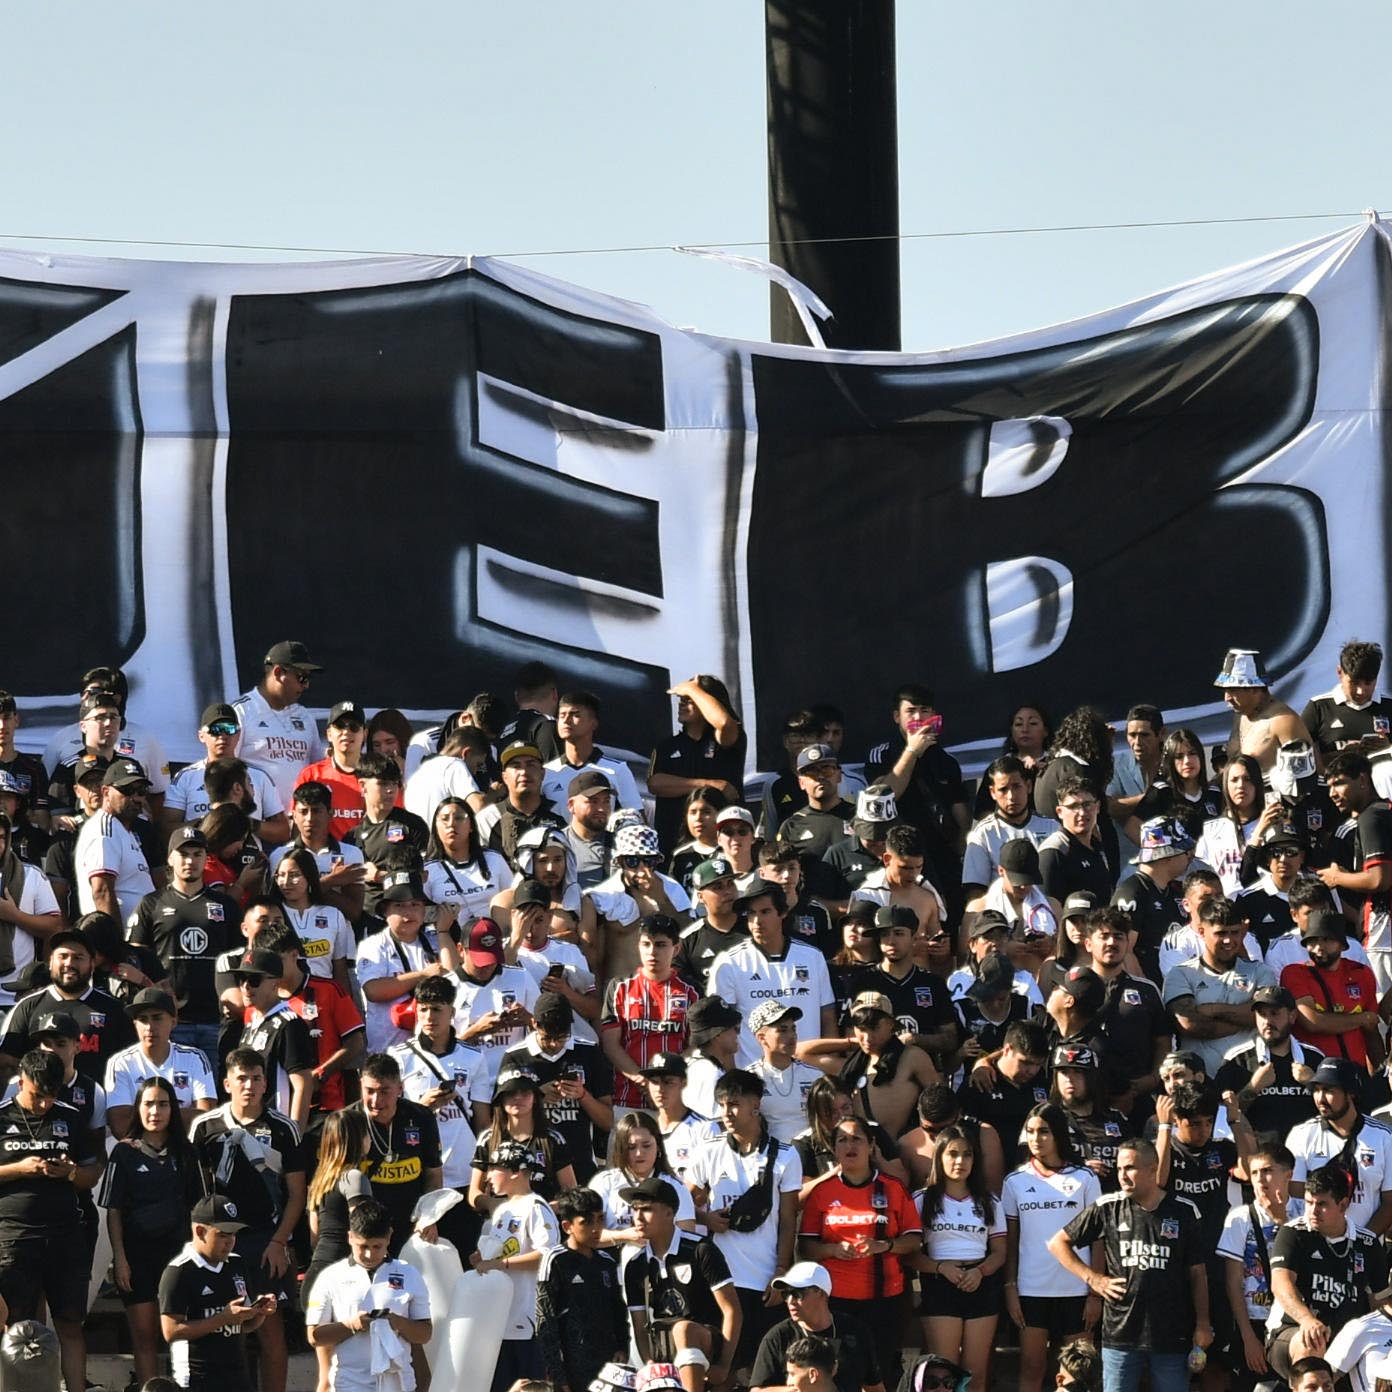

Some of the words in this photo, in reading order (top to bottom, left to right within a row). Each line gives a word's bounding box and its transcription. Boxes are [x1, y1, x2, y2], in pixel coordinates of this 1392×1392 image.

[266, 737, 308, 754] Pilsen
[270, 750, 285, 761] del
[285, 750, 306, 763] Sur
[180, 927, 208, 956] MG
[750, 987, 797, 999] COOLBET
[630, 1020, 681, 1033] DIRECTV
[551, 1107, 579, 1124] Sur
[4, 1140, 53, 1152] COOLBET
[1019, 1200, 1063, 1211] COOLBET
[931, 1221, 979, 1234] COOLBET
[1119, 1239, 1171, 1258] Pilsen
[1138, 1255, 1169, 1272] Sur
